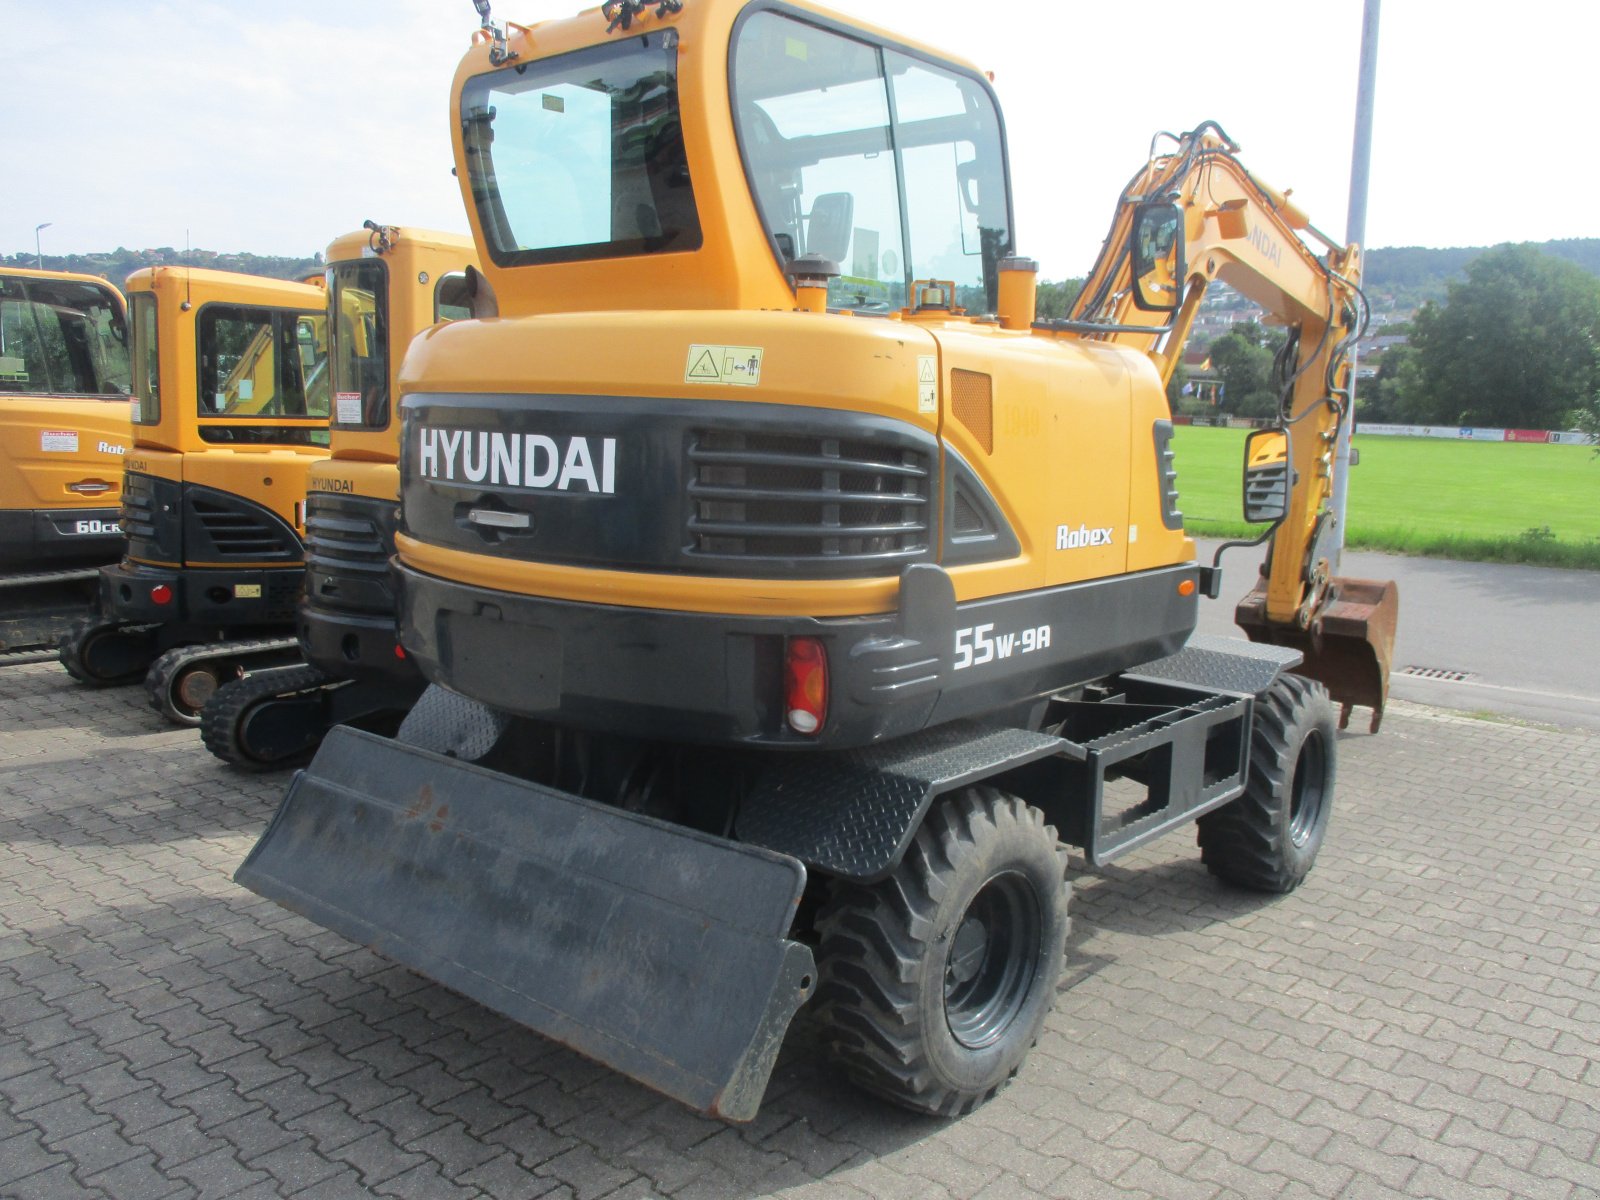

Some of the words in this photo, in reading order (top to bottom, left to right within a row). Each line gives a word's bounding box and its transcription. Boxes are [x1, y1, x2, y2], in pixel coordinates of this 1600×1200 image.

[420, 428, 616, 494] HYUNDAI
[312, 477, 354, 493] HYUNDAI
[1055, 523, 1114, 550] Robex
[953, 622, 1051, 670] 55W-9A
